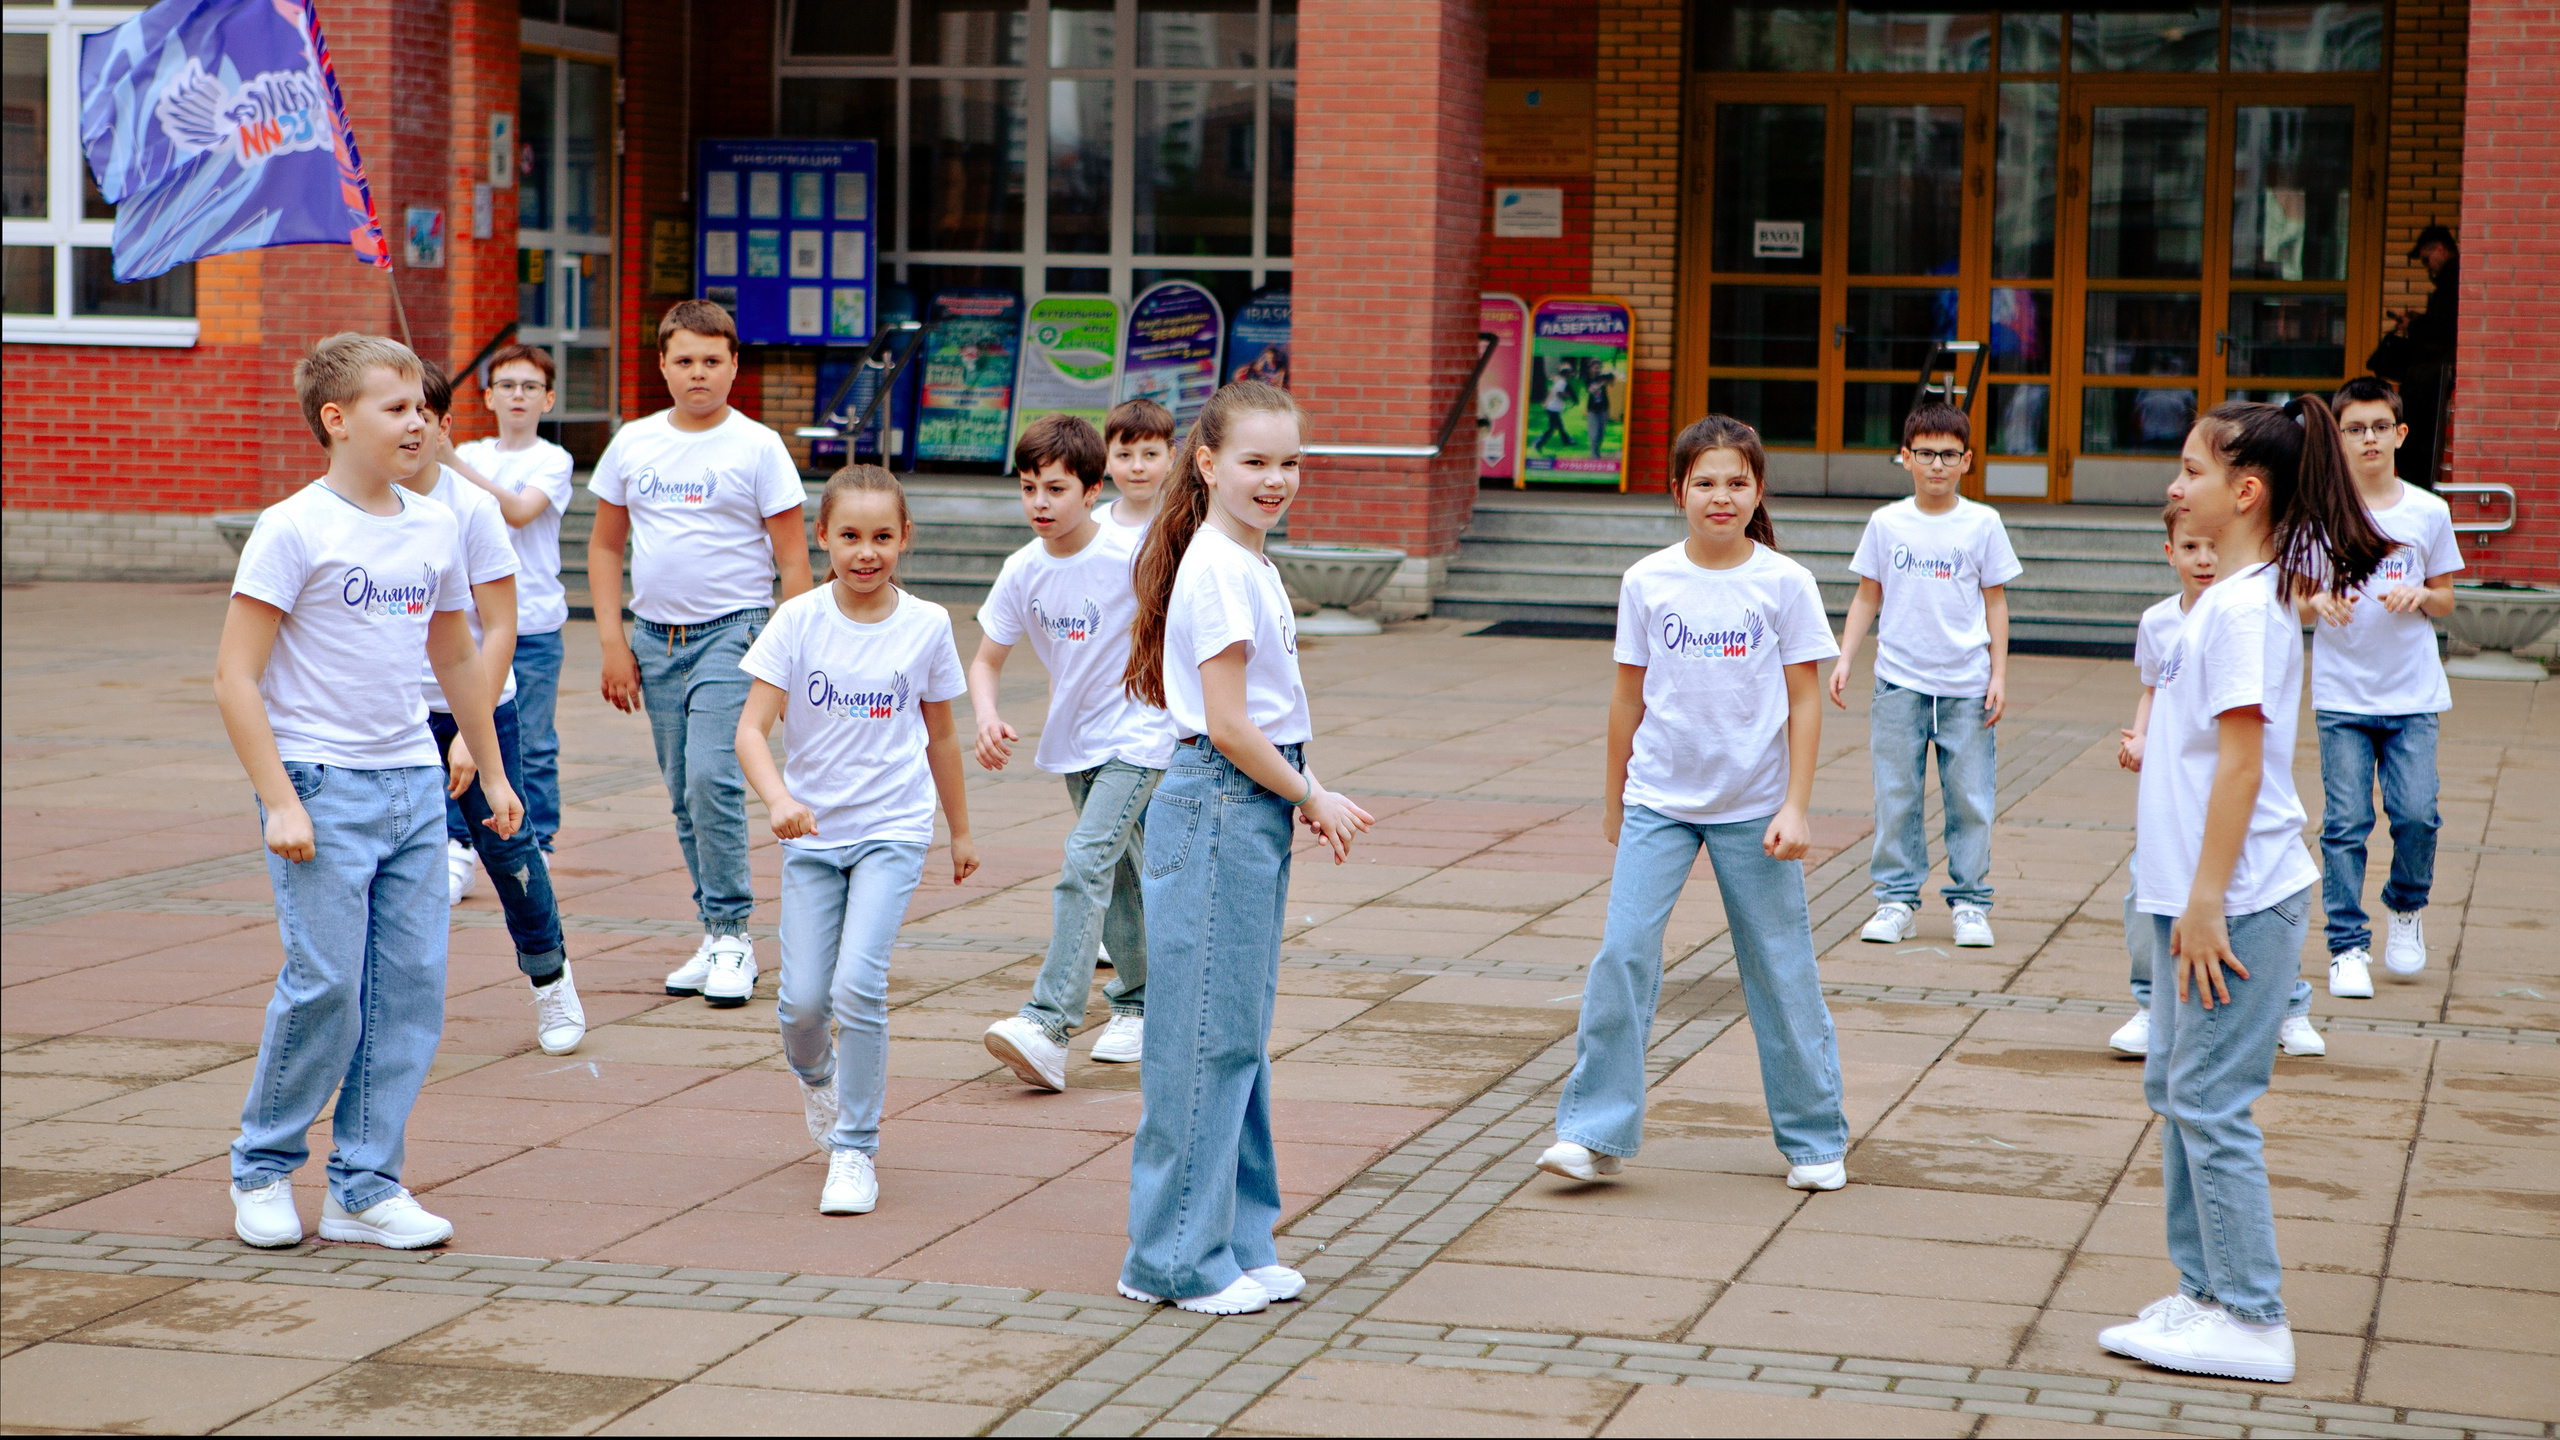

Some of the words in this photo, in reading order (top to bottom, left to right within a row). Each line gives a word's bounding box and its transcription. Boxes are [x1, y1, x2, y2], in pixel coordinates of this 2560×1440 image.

[732, 154, 842, 167] ИНФОРМАЦИЯ
[1540, 320, 1626, 335] ЛАЗЕРТАГА
[638, 467, 704, 499] Орлята
[1894, 544, 1952, 573] Орлята
[343, 566, 426, 611] Орлята
[1663, 612, 1747, 653] Орлята
[807, 670, 893, 711] Орлята
